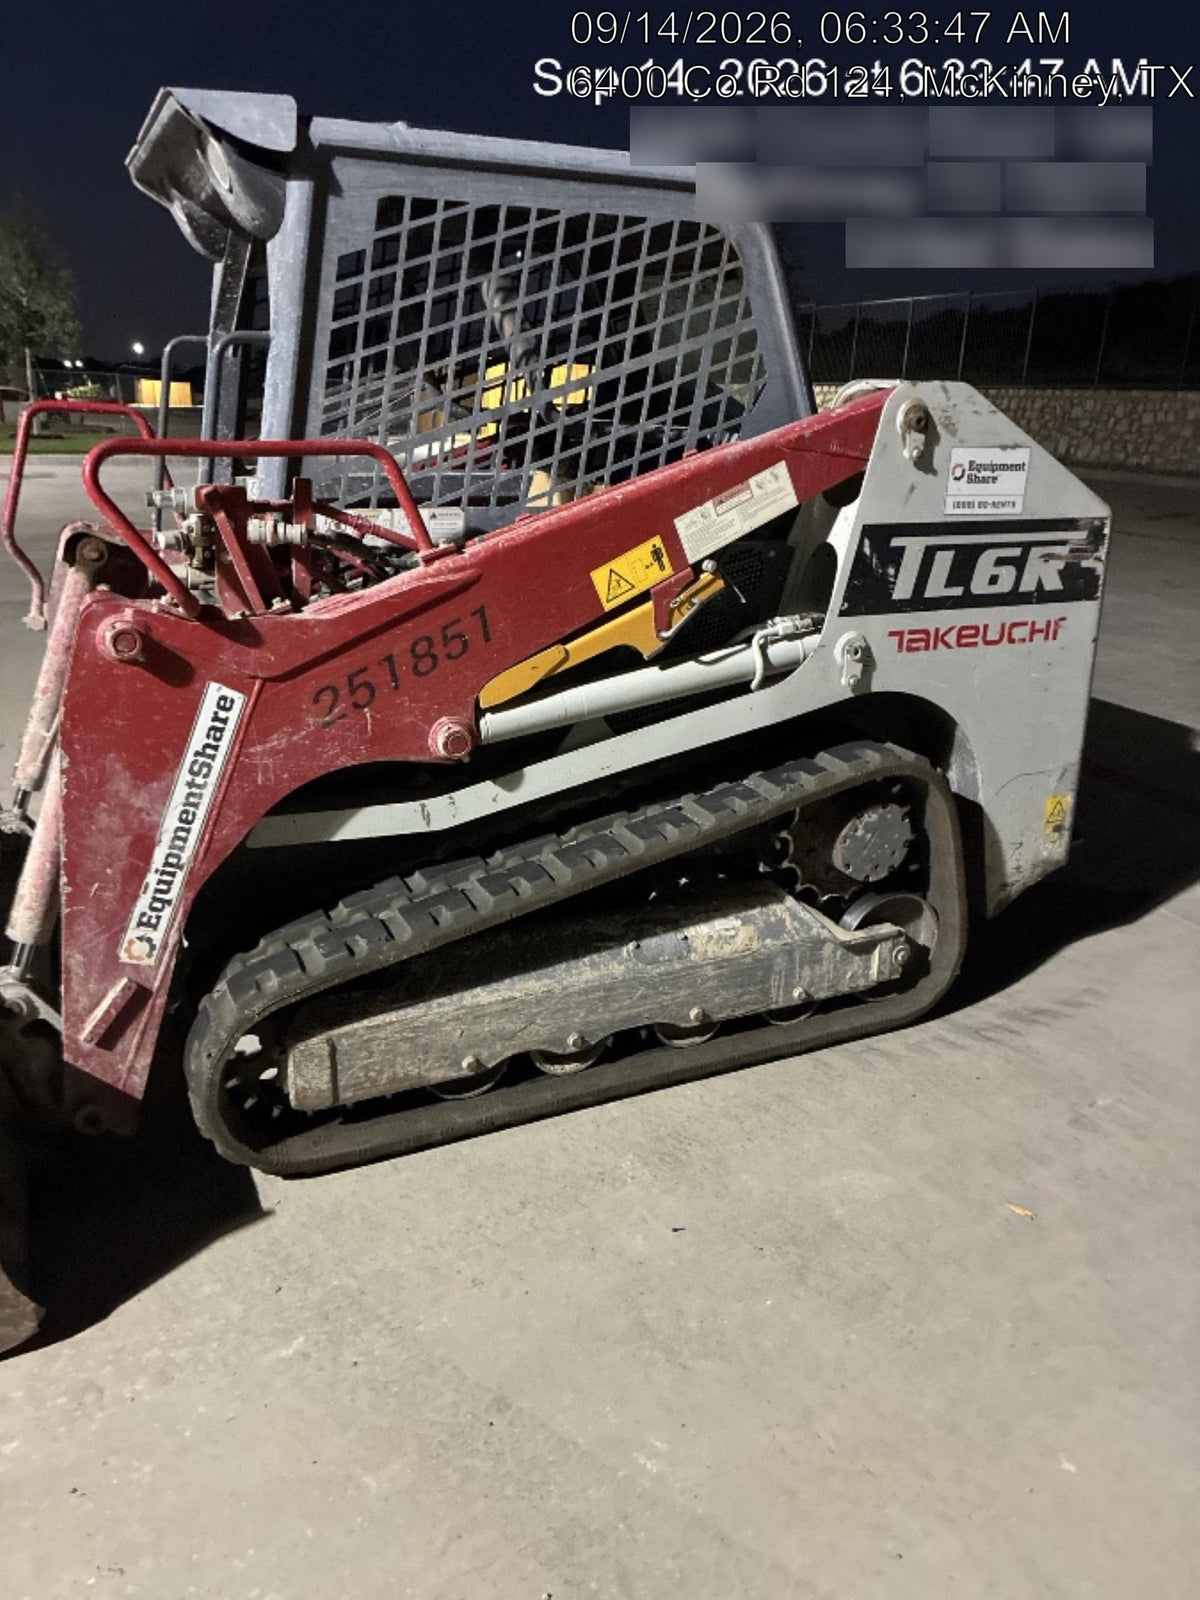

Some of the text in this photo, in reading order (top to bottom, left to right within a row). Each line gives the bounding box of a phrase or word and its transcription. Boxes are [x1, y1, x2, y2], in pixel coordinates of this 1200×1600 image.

[966, 472, 998, 484] Share
[967, 459, 1026, 474] Equipment
[890, 530, 1089, 600] TL6R
[312, 605, 492, 729] 251851
[136, 693, 235, 932] EquipmentShare
